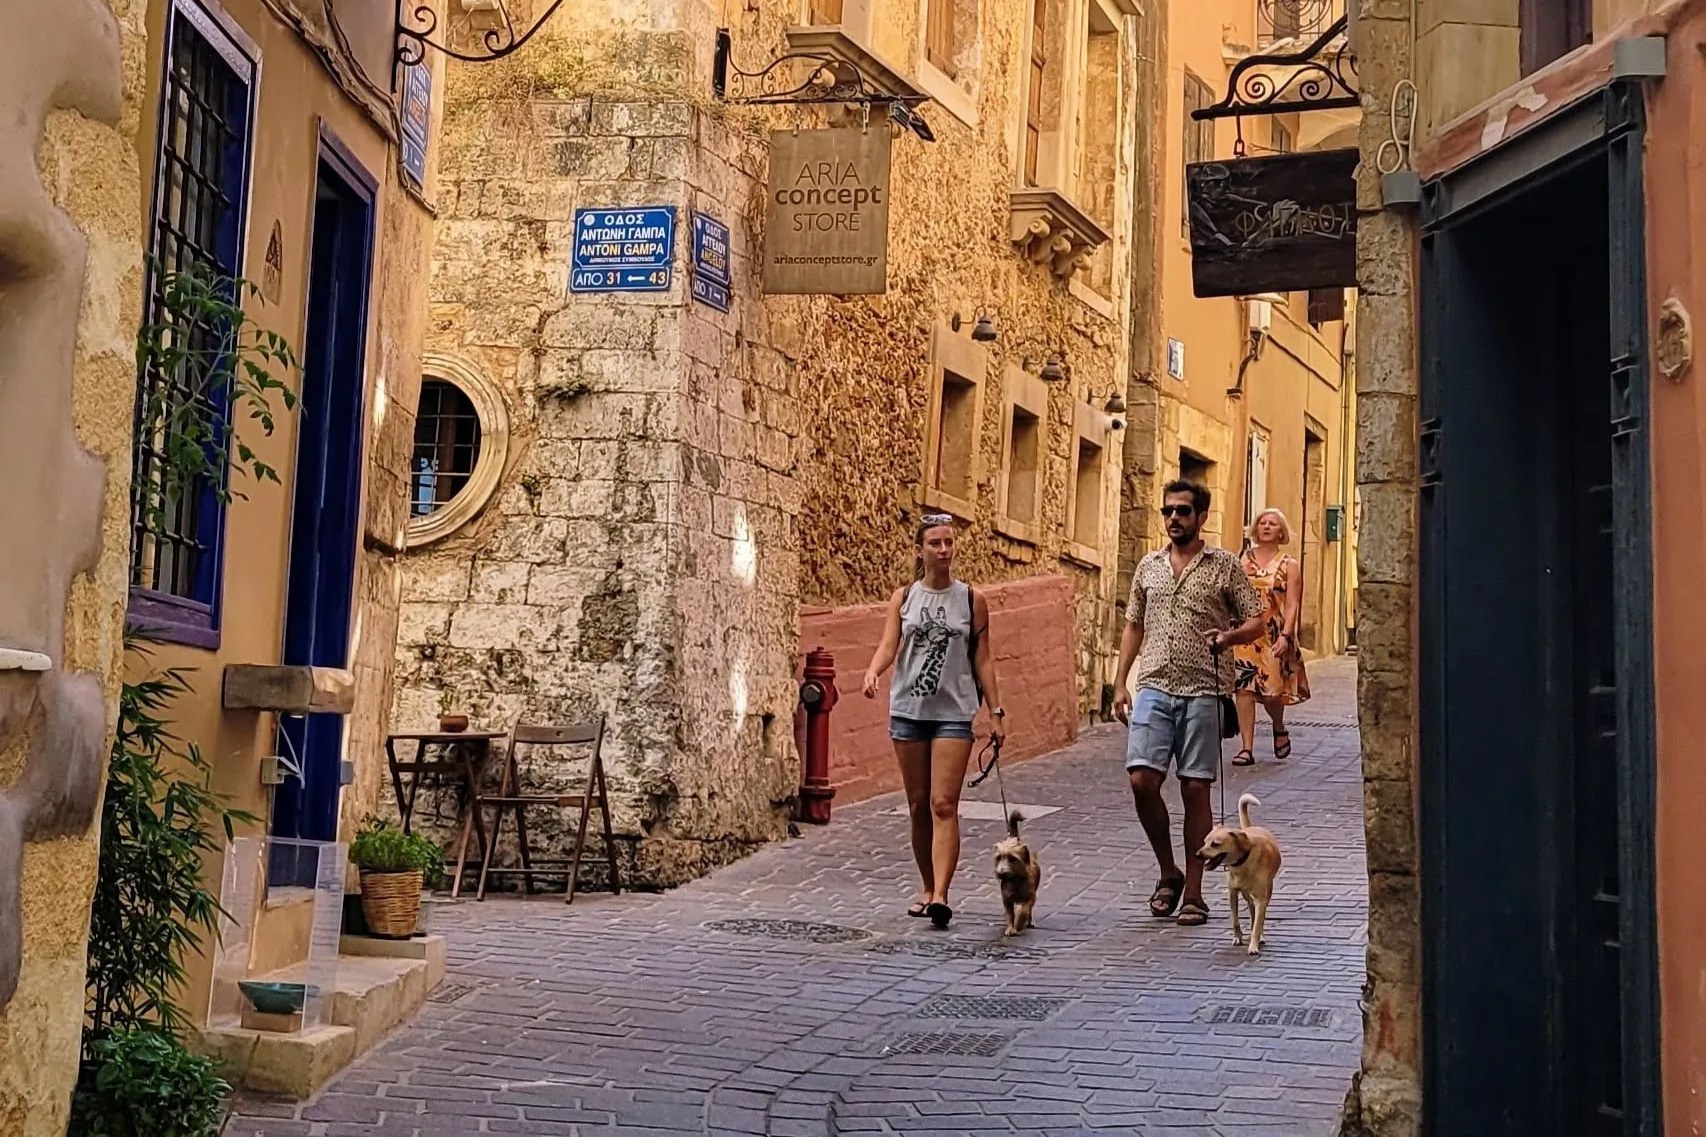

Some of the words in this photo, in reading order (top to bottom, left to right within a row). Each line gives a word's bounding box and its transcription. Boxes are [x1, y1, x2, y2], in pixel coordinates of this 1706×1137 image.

[795, 162, 861, 186] ARIA
[774, 184, 883, 211] concept
[604, 213, 645, 226] ΟΔΟΣ
[792, 212, 861, 232] STORE
[580, 227, 626, 241] ΑΝΤΩΝΗ
[627, 226, 666, 240] ΓΑΜΠΑ
[579, 243, 622, 257] ANTONI
[623, 242, 665, 256] GAMPA
[773, 255, 879, 267] ariaconceptstore.gr
[575, 272, 603, 286] ΑΠΟ
[606, 271, 622, 285] 31
[649, 271, 666, 284] 43
